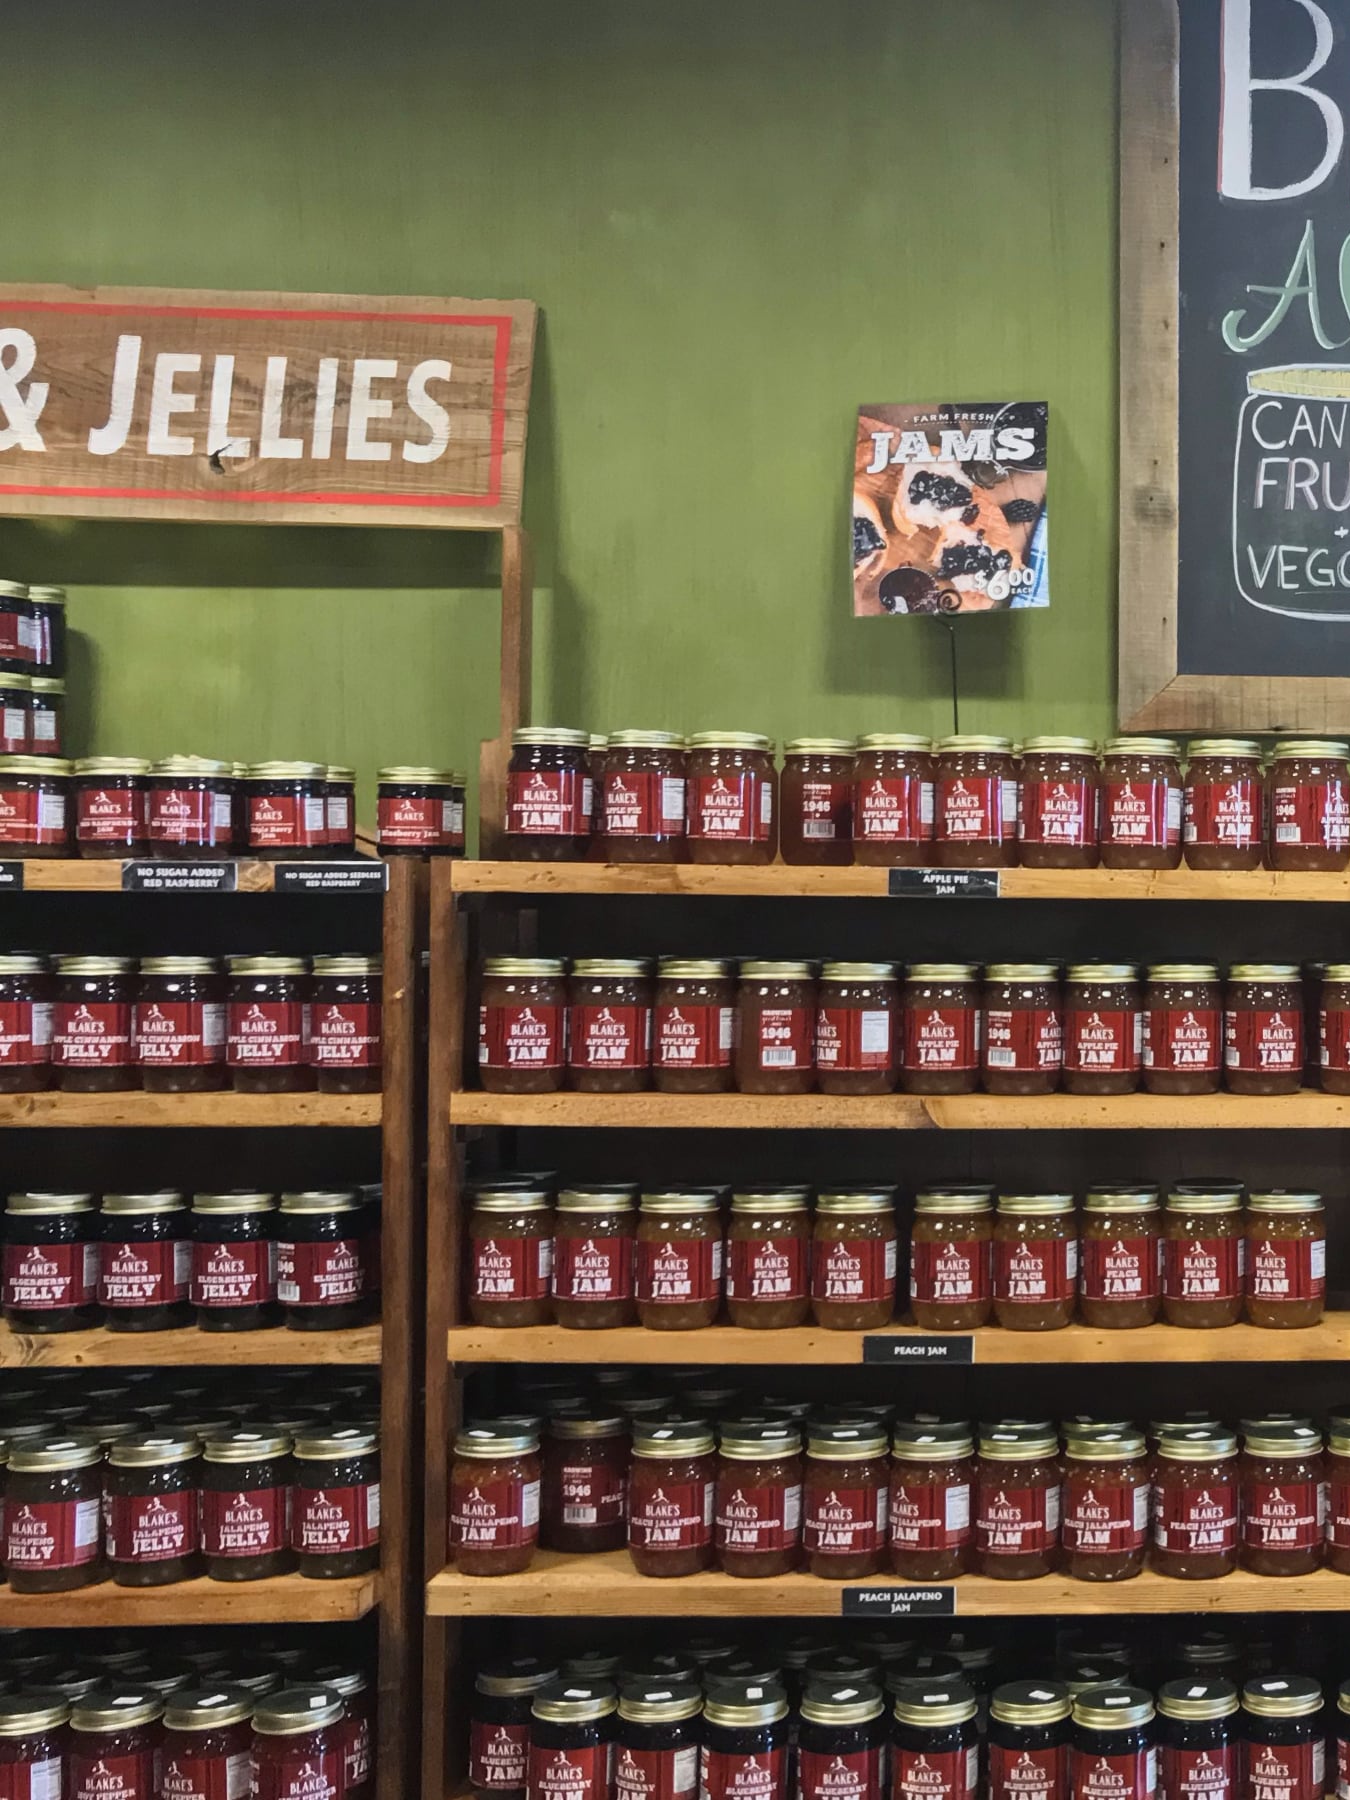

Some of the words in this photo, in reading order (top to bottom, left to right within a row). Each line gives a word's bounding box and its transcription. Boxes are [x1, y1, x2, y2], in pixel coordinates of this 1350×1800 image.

[0, 327, 49, 452] &
[88, 334, 452, 463] JELLIES
[914, 415, 948, 423] FARM
[954, 413, 994, 421] FRESH
[867, 428, 1035, 474] JAMS
[523, 791, 557, 801] BLAKE'S
[706, 796, 739, 806] BLAKE'S
[804, 801, 830, 811] 1946
[866, 797, 897, 807] BLAKE'S
[1114, 801, 1145, 812] BLAKE'S
[521, 812, 560, 830] JAM
[703, 817, 740, 834] JAM
[864, 819, 899, 834] JAM
[1112, 823, 1146, 838] JAM
[166, 879, 218, 887] RASPBERRY
[923, 875, 951, 883] APPLE
[953, 875, 968, 883] PIE
[937, 886, 955, 894] JAM
[68, 1022, 104, 1033] BLAKE'S
[143, 1021, 174, 1032] BLAKE'S
[511, 1025, 546, 1035] BLAKE'S
[762, 1028, 790, 1038] 1946
[1082, 1029, 1113, 1040] BLAKE'S
[63, 1045, 111, 1059] JELLY
[140, 1044, 183, 1059] JELLY
[508, 1047, 547, 1062] JAM
[1079, 1050, 1115, 1064] JAM
[208, 1261, 244, 1272] BLAKE'S
[575, 1257, 609, 1267] BLAKE'S
[828, 1259, 860, 1270] BLAKE'S
[1106, 1257, 1138, 1268] BLAKE'S
[20, 1263, 57, 1275] BLAKE'S
[572, 1279, 611, 1293] JAM
[826, 1280, 863, 1295] JAM
[1104, 1279, 1141, 1294] JAM
[13, 1285, 65, 1304] JELLY
[202, 1284, 251, 1301] JELLY
[928, 1346, 947, 1356] JAM
[307, 1508, 342, 1519] BLAKE'S
[646, 1505, 680, 1516] BLAKE'S
[1263, 1505, 1296, 1516] BLAKE'S
[139, 1512, 177, 1527] BLAKE'S
[303, 1529, 349, 1546] JELLY
[645, 1528, 680, 1544] JAM
[1262, 1527, 1297, 1542] JAM
[132, 1534, 182, 1555] JELLY
[860, 1593, 890, 1601] PEACH
[894, 1592, 942, 1602] JALAPENO
[891, 1604, 910, 1613] JAM
[547, 1768, 582, 1779] BLAKE'S
[1189, 1767, 1223, 1780] BLAKE'S
[86, 1776, 123, 1790] BLAKE'S
